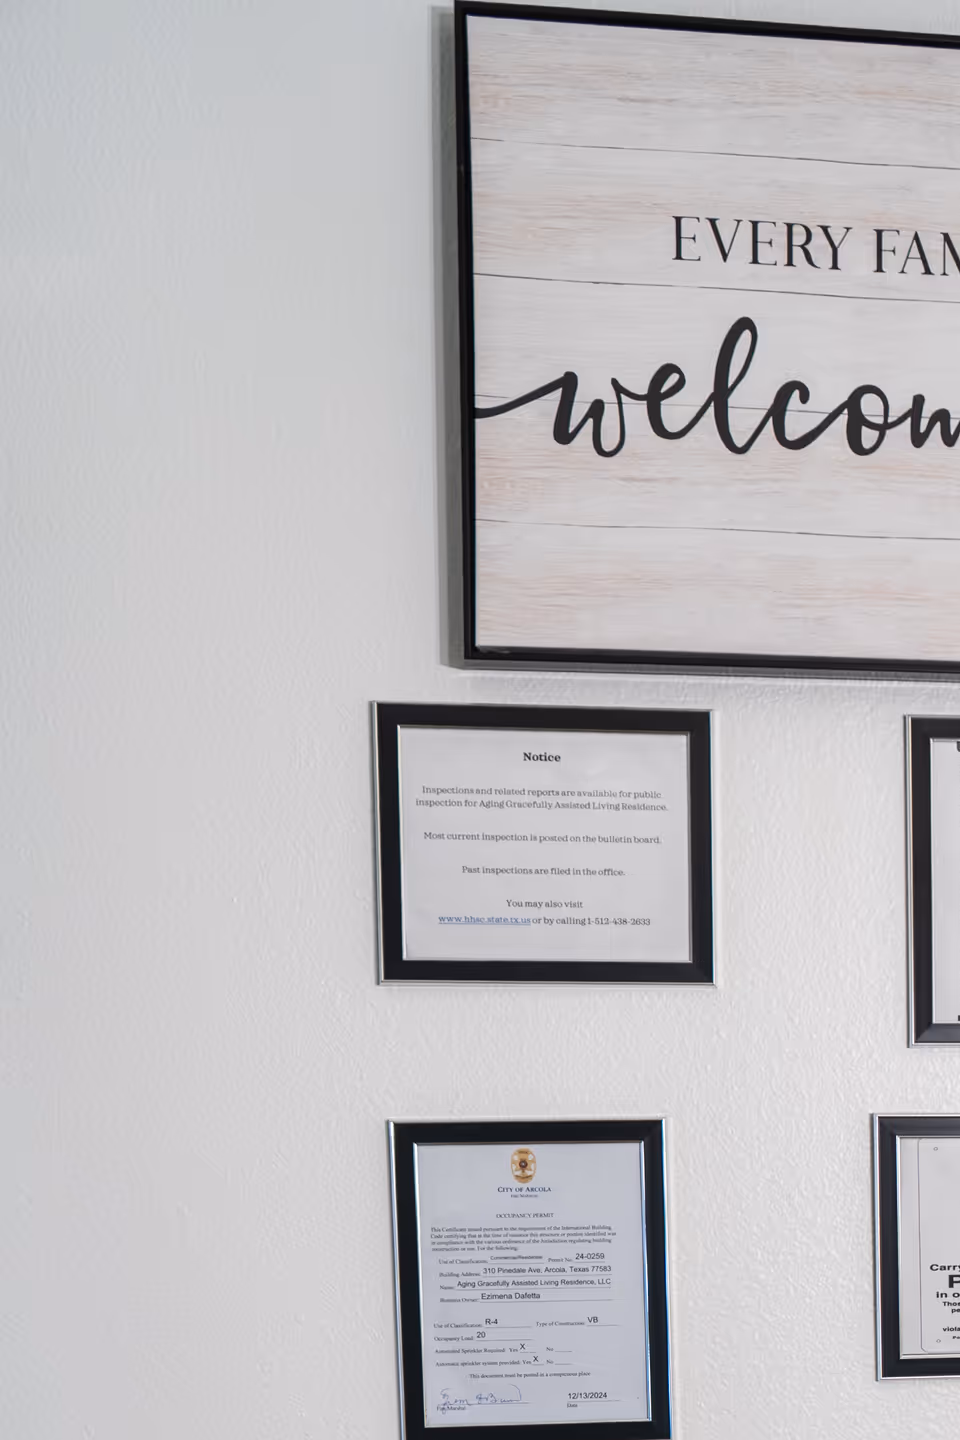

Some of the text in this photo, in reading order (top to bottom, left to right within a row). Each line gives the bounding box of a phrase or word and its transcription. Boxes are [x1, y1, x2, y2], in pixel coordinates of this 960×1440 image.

[672, 215, 853, 271] EVERY
[523, 751, 561, 762] Notice
[505, 899, 583, 909] You may also visit
[542, 916, 555, 926] by
[555, 916, 587, 927] calling
[587, 917, 651, 926] 1-512-438-2633
[575, 1252, 605, 1260] 24-0259
[569, 1265, 590, 1273] Texas
[456, 1280, 476, 1289] Aging
[476, 1279, 510, 1288] Gracefully
[539, 1279, 559, 1287] Living
[560, 1278, 596, 1286] Residence,
[597, 1277, 611, 1285] LLC
[935, 1291, 948, 1299] in
[587, 1316, 599, 1324] VB
[476, 1330, 486, 1339] 20
[567, 1391, 608, 1400] 12/13/2024
